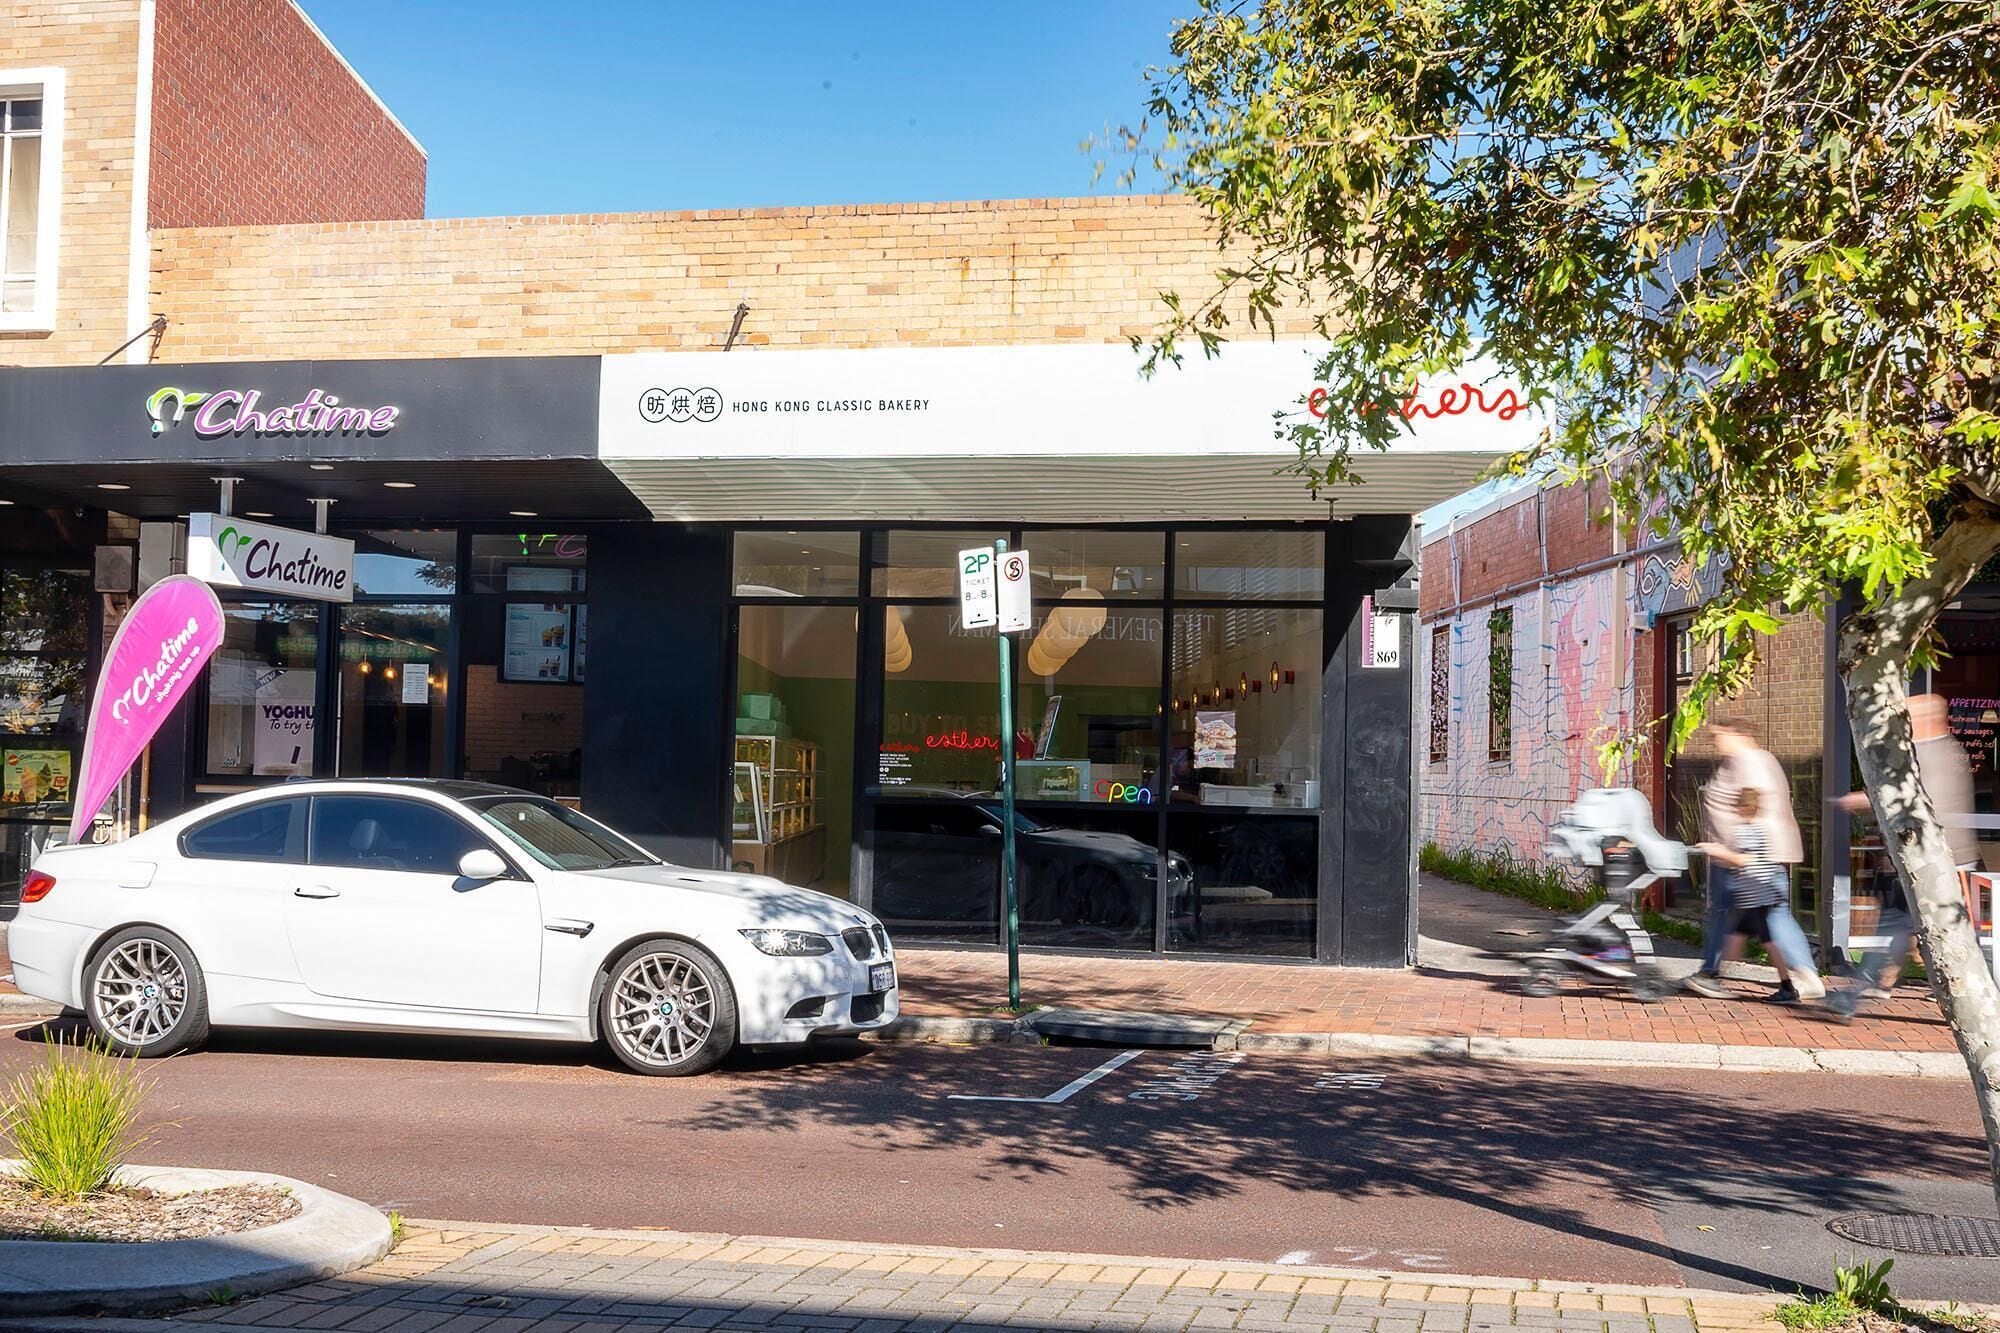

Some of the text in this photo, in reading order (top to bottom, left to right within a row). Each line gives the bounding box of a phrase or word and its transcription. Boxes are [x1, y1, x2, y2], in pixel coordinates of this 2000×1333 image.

[194, 388, 399, 435] Chatime
[647, 395, 716, 415] 昉烘焙
[733, 400, 930, 412] HONG KONG CLASSIC BAKERY
[245, 538, 347, 590] Chatime
[964, 554, 989, 574] 2P
[966, 577, 990, 586] TICKET
[133, 617, 198, 706] Chatime
[1376, 651, 1397, 664] 869
[270, 719, 281, 730] To
[284, 721, 302, 735] try
